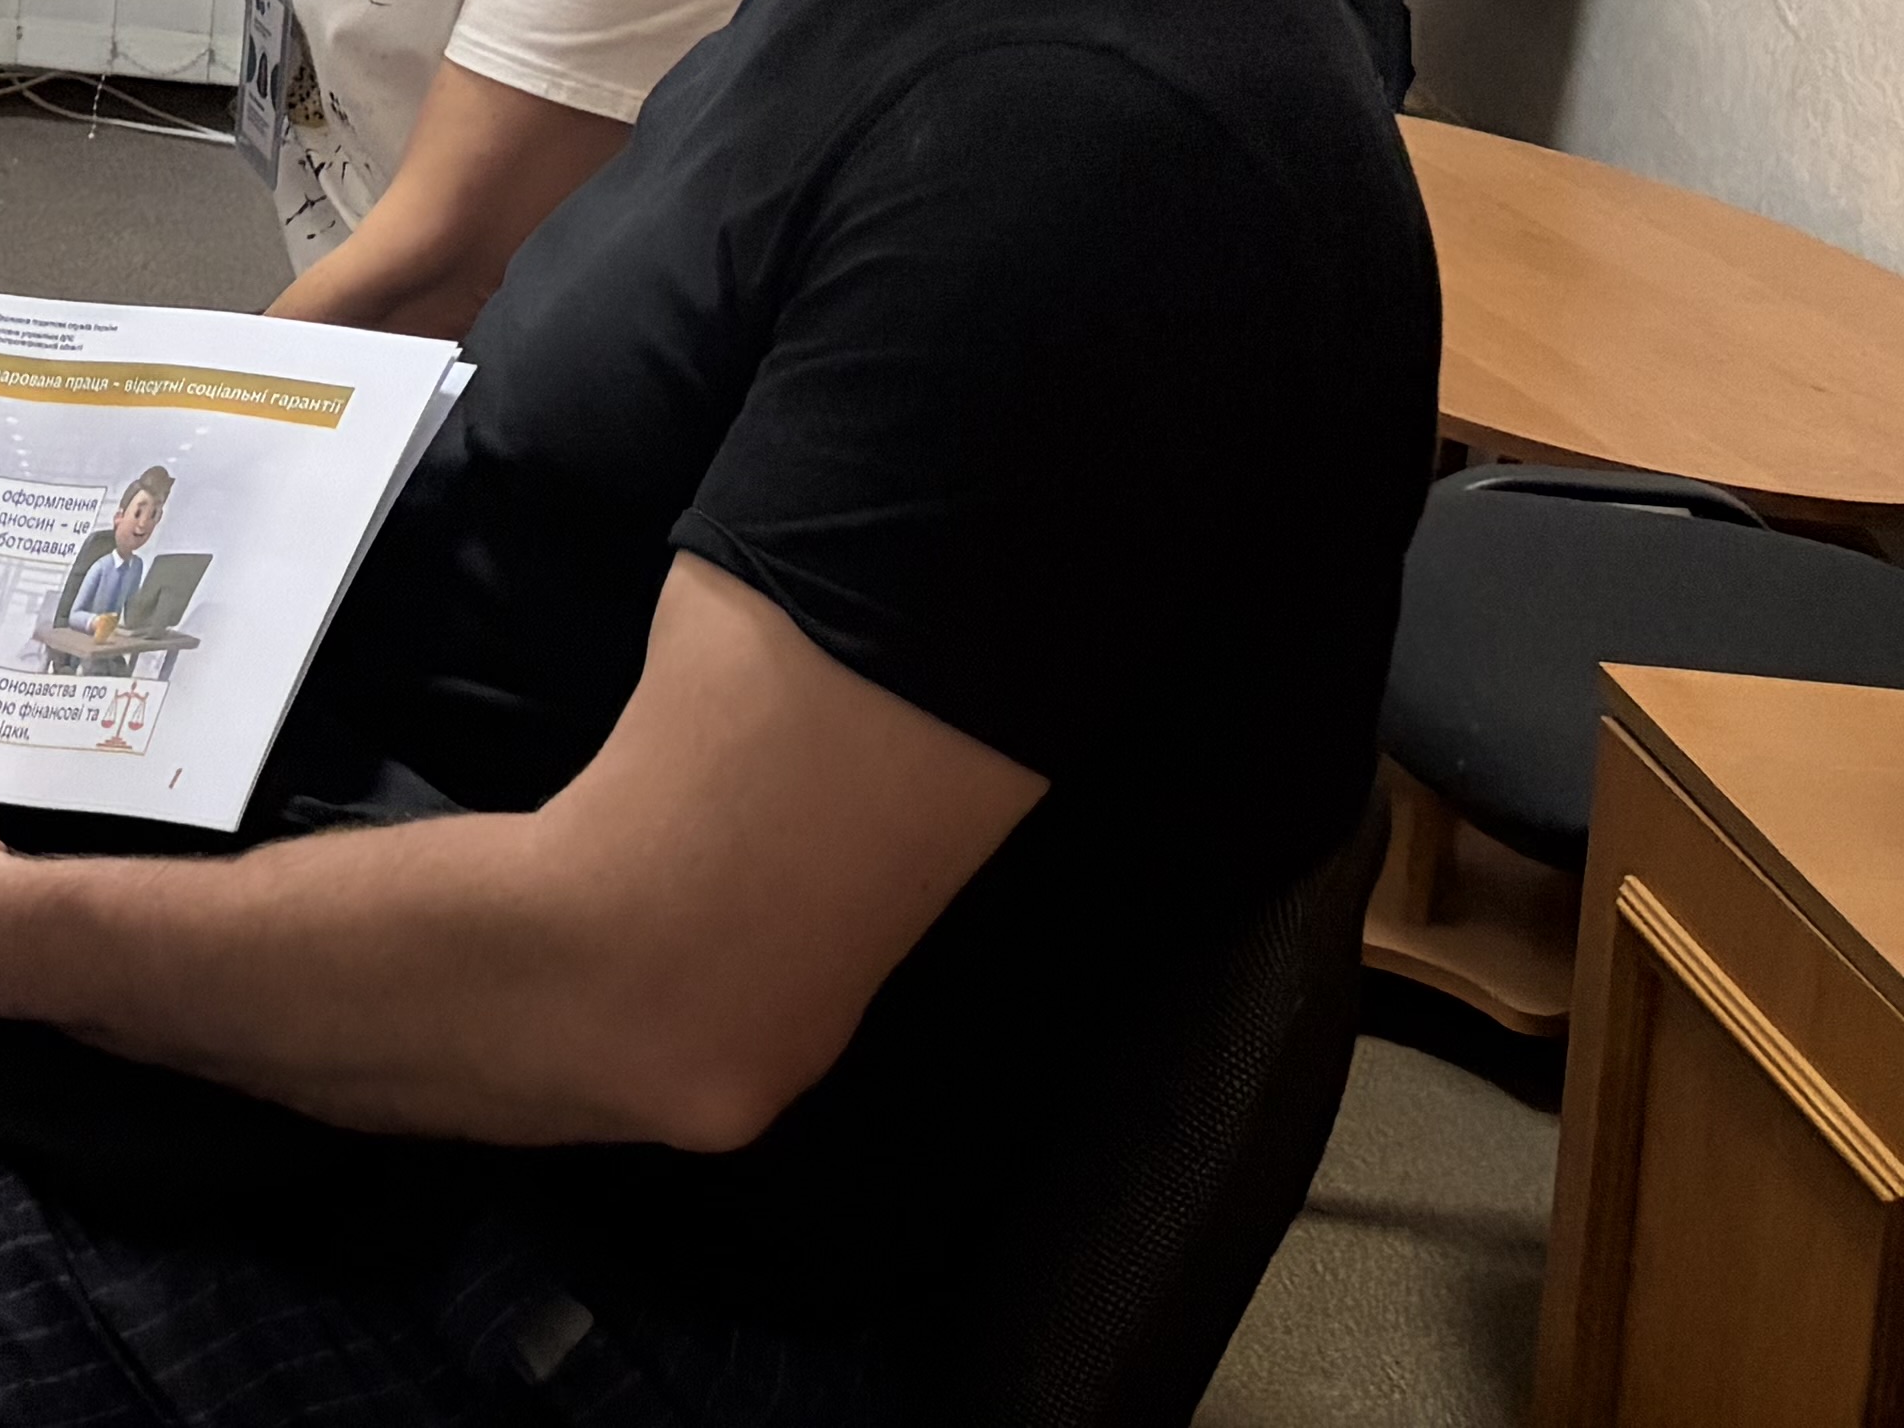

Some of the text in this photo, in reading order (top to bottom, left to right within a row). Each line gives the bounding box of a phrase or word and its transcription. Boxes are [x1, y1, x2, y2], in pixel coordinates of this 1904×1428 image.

[64, 376, 109, 392] праця
[124, 376, 185, 396] відсутні
[187, 382, 268, 403] соціальні
[270, 394, 344, 414] гарантії
[2, 489, 99, 512] оформлення
[73, 520, 91, 535] це
[82, 683, 107, 701] про
[19, 698, 85, 723] фінансові
[86, 707, 100, 722] та
